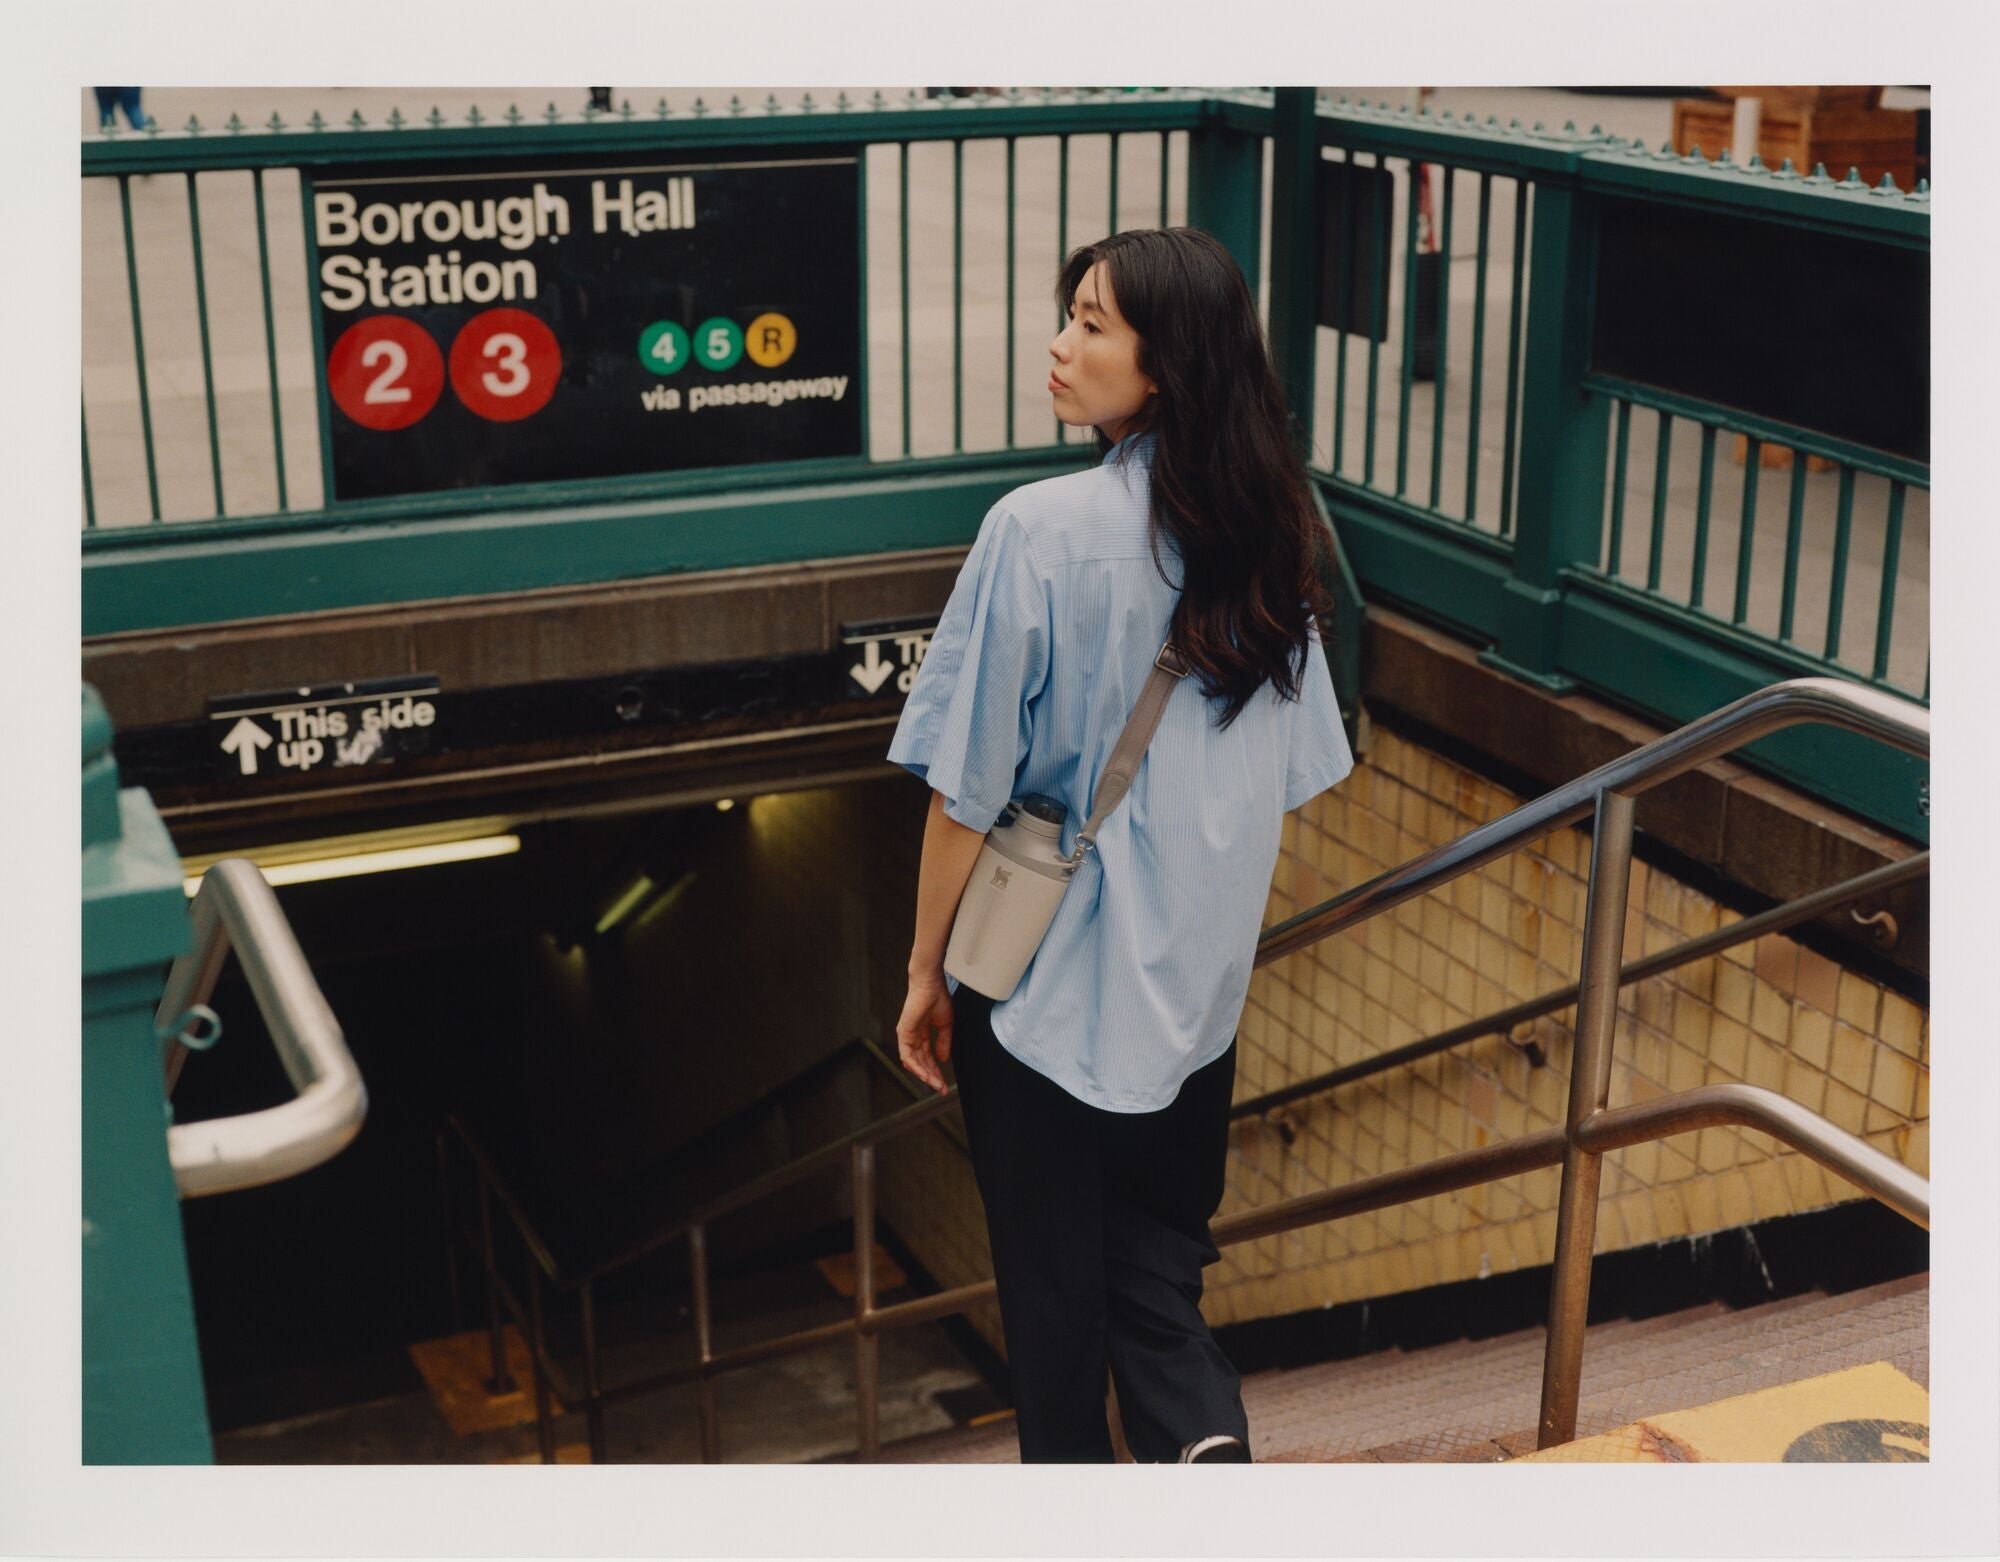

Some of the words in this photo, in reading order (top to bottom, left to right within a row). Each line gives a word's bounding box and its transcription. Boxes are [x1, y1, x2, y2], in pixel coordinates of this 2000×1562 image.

[314, 183, 570, 250] Borough
[592, 176, 695, 235] Hall
[319, 250, 538, 313] Station
[651, 331, 677, 364] 4
[707, 327, 732, 361] 5
[762, 327, 782, 353] R
[362, 339, 412, 406] 2
[481, 332, 532, 398] 3
[641, 384, 681, 412] via
[688, 375, 849, 413] passageway
[272, 705, 349, 742] This
[361, 697, 436, 731] side
[276, 738, 324, 771] up
